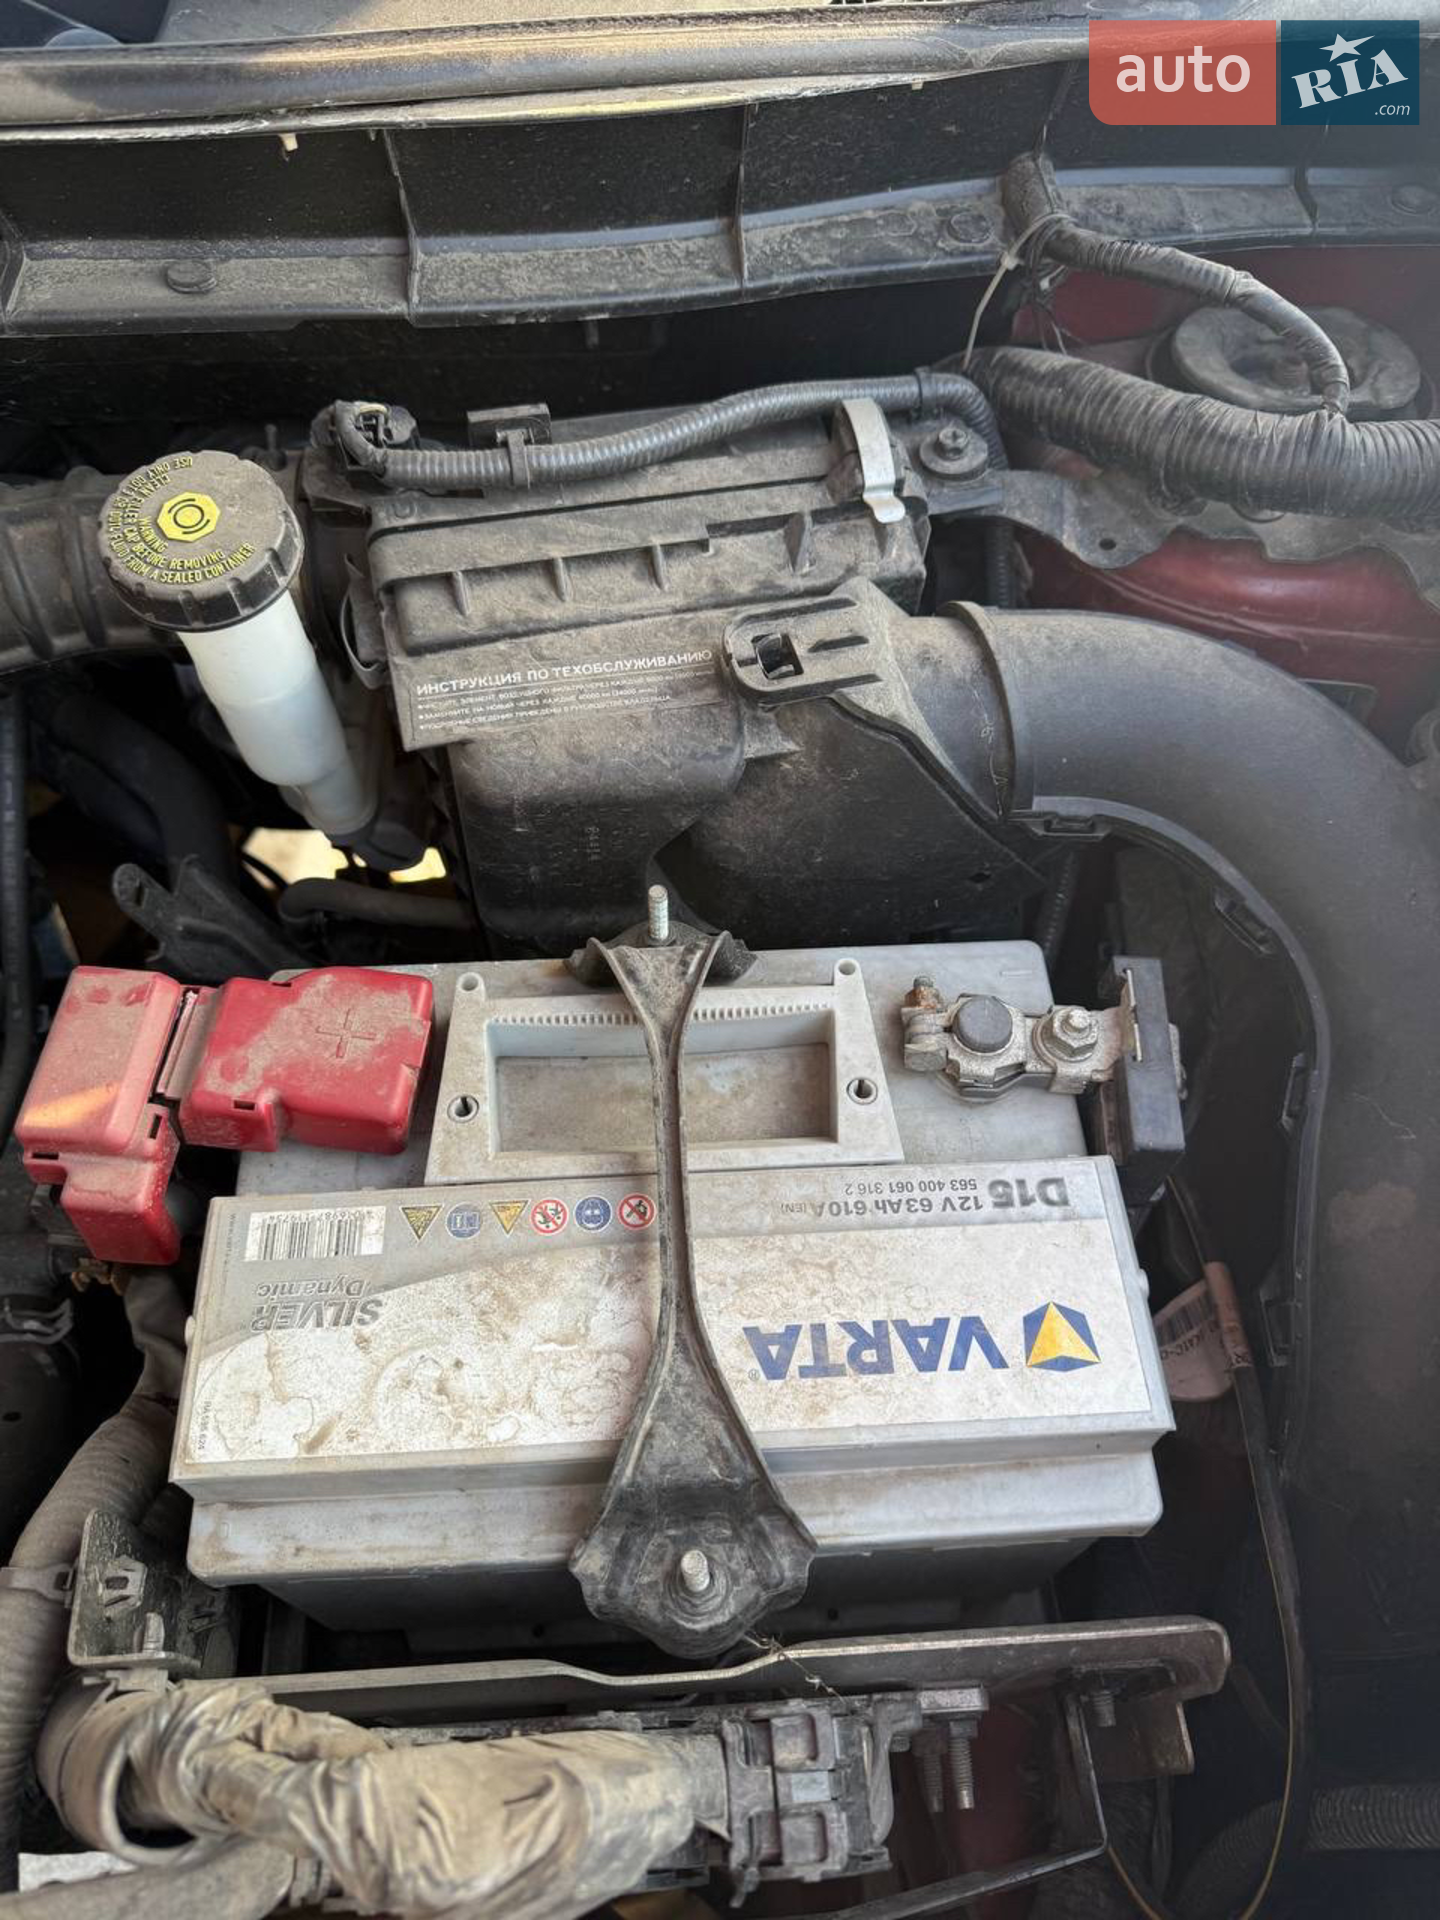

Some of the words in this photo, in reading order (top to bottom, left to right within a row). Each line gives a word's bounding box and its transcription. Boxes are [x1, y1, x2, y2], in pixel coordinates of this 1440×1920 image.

[147, 461, 170, 479] ONLY
[174, 456, 193, 469] USE
[139, 473, 172, 497] CLEAN
[122, 526, 141, 543] CAP
[137, 514, 169, 553] WARNING
[131, 542, 168, 568] BEFORE
[168, 548, 226, 570] REMOVING
[203, 541, 257, 580] CONTAINER
[122, 554, 152, 577] FROM
[149, 569, 159, 581] A
[160, 568, 203, 584] SEALED
[416, 671, 522, 696] ИНСТРУКЦИЯ
[527, 668, 549, 682] ПО
[551, 649, 713, 678] ТЕХОБСЛУЖИВАНИЮ
[844, 1183, 852, 1195] 2
[857, 1182, 884, 1194] 316
[888, 1180, 916, 1193] 061
[919, 1179, 946, 1192] 400
[950, 1178, 978, 1191] 563
[988, 1177, 1072, 1208] D15
[875, 1197, 934, 1215] 63Ah
[940, 1195, 983, 1212] 12V
[257, 1274, 366, 1301] Dynamic
[251, 1298, 384, 1331] SILVER
[742, 1316, 1010, 1381] VARTA
